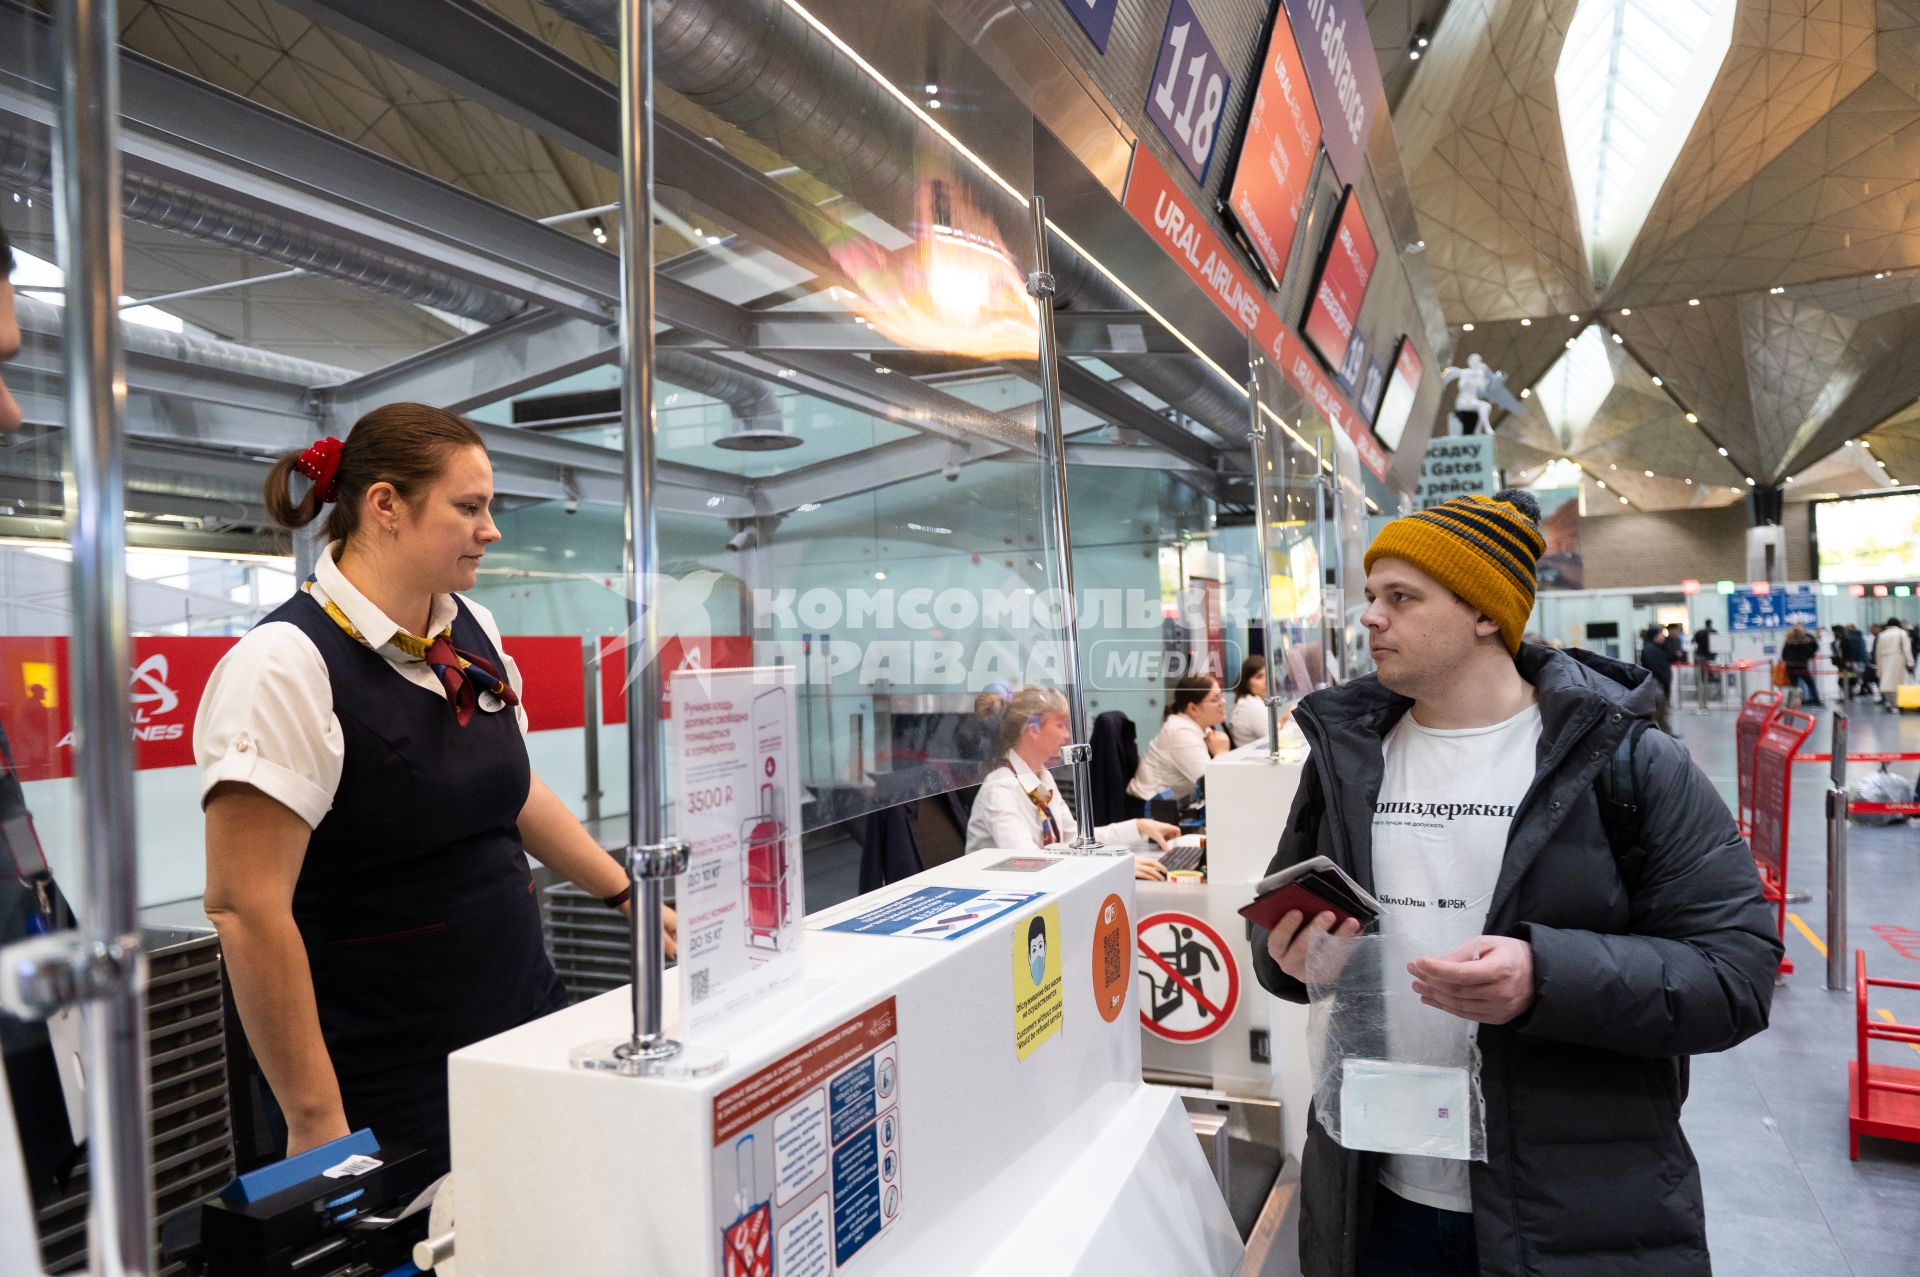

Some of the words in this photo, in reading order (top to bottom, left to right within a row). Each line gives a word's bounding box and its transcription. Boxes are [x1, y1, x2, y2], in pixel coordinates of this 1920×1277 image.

[1321, 4, 1365, 145] advance
[1155, 21, 1223, 164] 118
[1154, 191, 1203, 269] URAL
[1200, 251, 1260, 329] AIRLINES
[1432, 461, 1483, 477] Gates
[1428, 478, 1484, 496] рейсы
[684, 702, 710, 714] Ручная
[687, 788, 721, 813] 3500
[1379, 895, 1426, 908] SlovoDna
[1447, 899, 1466, 909] РБК
[1016, 989, 1044, 1013] Обслуживание
[1017, 1020, 1037, 1040] Customers
[1038, 1008, 1051, 1024] without
[1052, 1000, 1063, 1012] masks
[1031, 1032, 1036, 1040] be
[1036, 1019, 1050, 1036] refused
[1050, 1011, 1062, 1025] service
